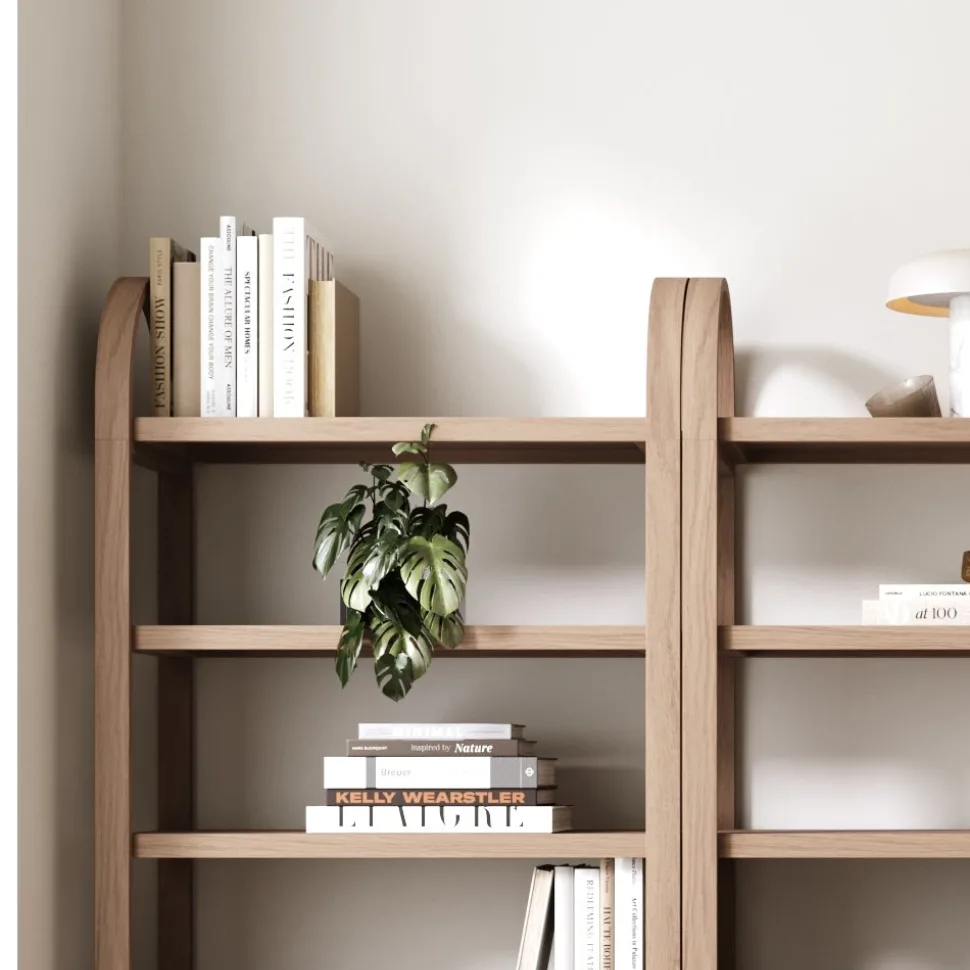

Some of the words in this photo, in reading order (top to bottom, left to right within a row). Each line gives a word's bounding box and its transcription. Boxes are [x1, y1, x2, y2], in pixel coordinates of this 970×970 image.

[224, 267, 233, 286] THE
[154, 297, 165, 339] SHOW
[224, 289, 233, 328] ALLURE
[282, 272, 295, 353] FASHION
[224, 330, 233, 343] OF
[224, 345, 233, 368] MEN
[154, 346, 165, 409] FASHION
[915, 607, 930, 619] at
[932, 607, 958, 619] 100
[411, 743, 440, 752] Inspired
[442, 743, 450, 752] by
[454, 743, 493, 753] Nature
[381, 768, 411, 776] Breuer
[335, 792, 396, 803] KELLY
[402, 792, 525, 803] WEARSTLER
[586, 880, 594, 939] REDEEMING
[603, 906, 611, 942] HAUTE
